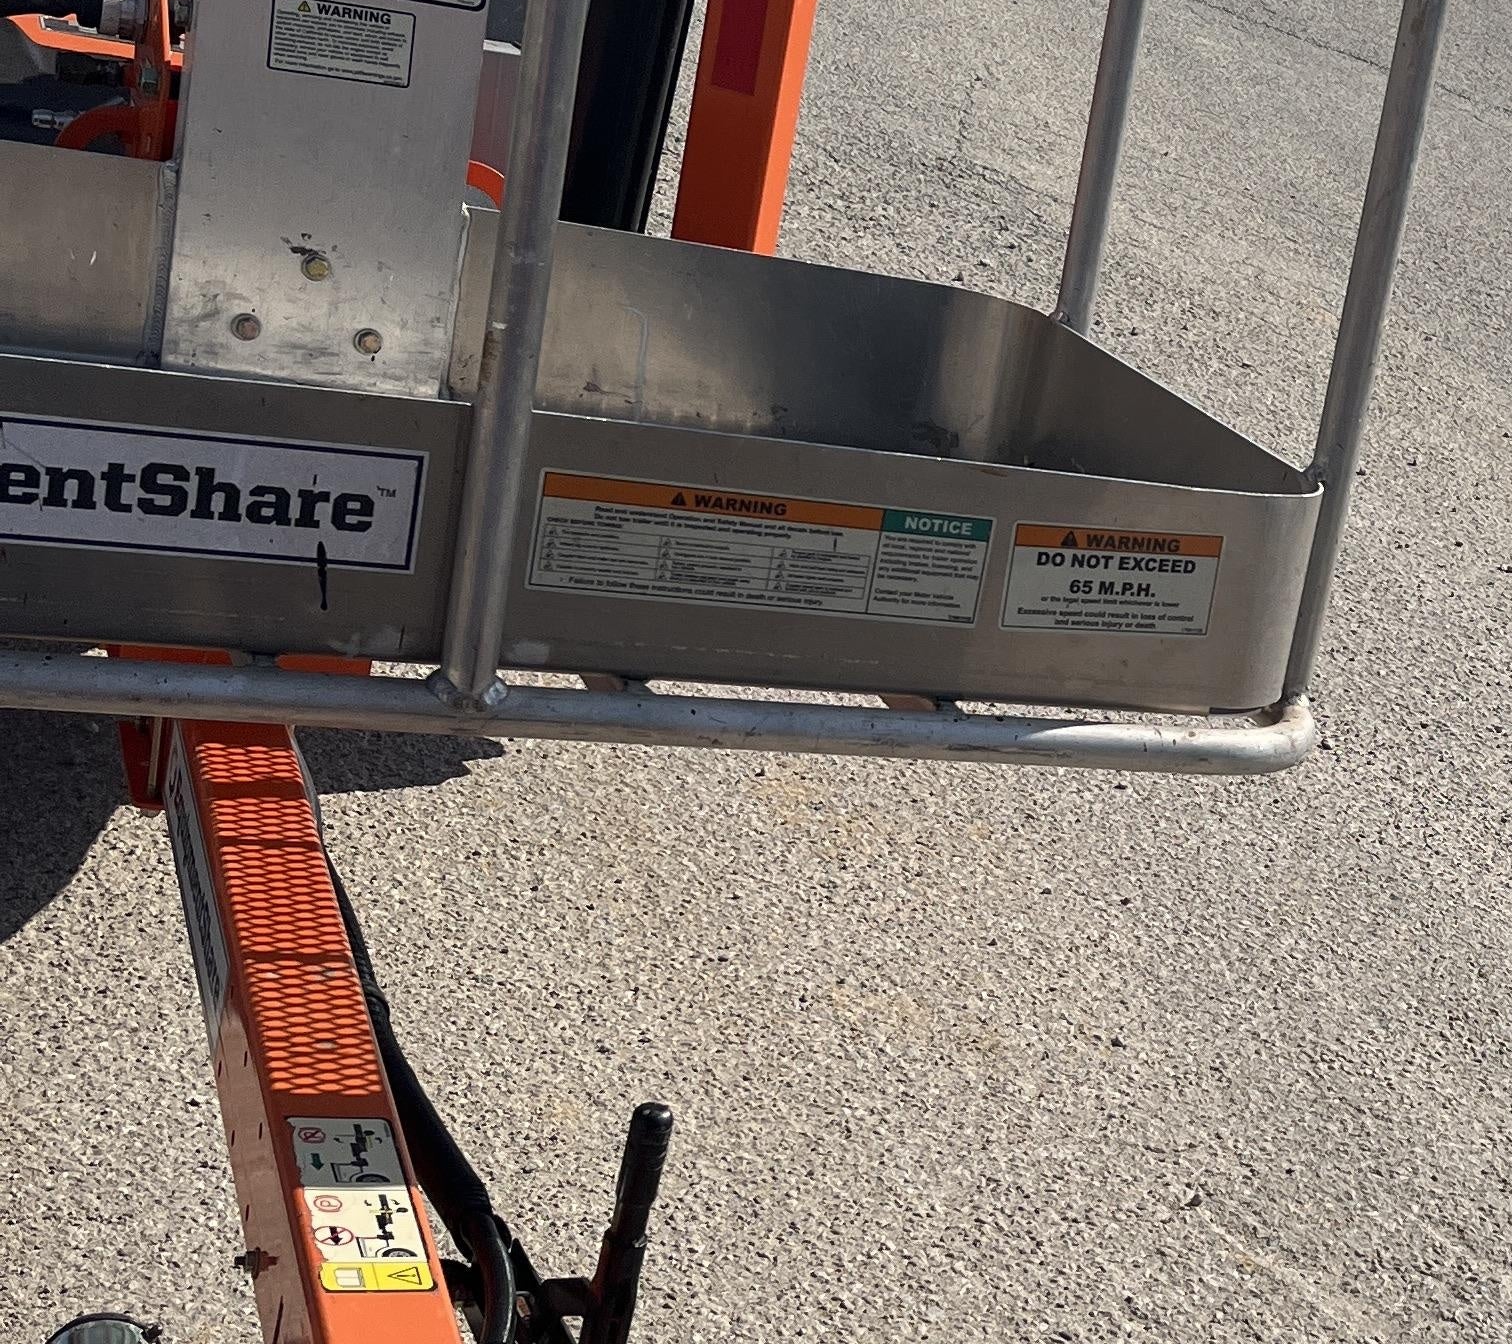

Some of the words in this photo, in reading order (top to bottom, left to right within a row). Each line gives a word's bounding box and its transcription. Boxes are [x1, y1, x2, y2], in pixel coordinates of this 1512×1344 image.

[316, 3, 391, 24] WARNING
[0, 462, 375, 533] entShare
[693, 494, 787, 516] WARNING
[904, 516, 972, 535] NOTICE
[1085, 533, 1181, 552] WARNING
[1036, 551, 1065, 567] DO
[1070, 553, 1114, 569] NOT
[1118, 556, 1196, 574] EXCEED
[1068, 579, 1093, 594] 65
[1098, 581, 1157, 597] M.P.H.
[1017, 607, 1057, 615] Excessive
[1058, 609, 1082, 618] speed
[1083, 610, 1105, 618] could
[1107, 611, 1130, 619] result
[1100, 620, 1123, 628] injury
